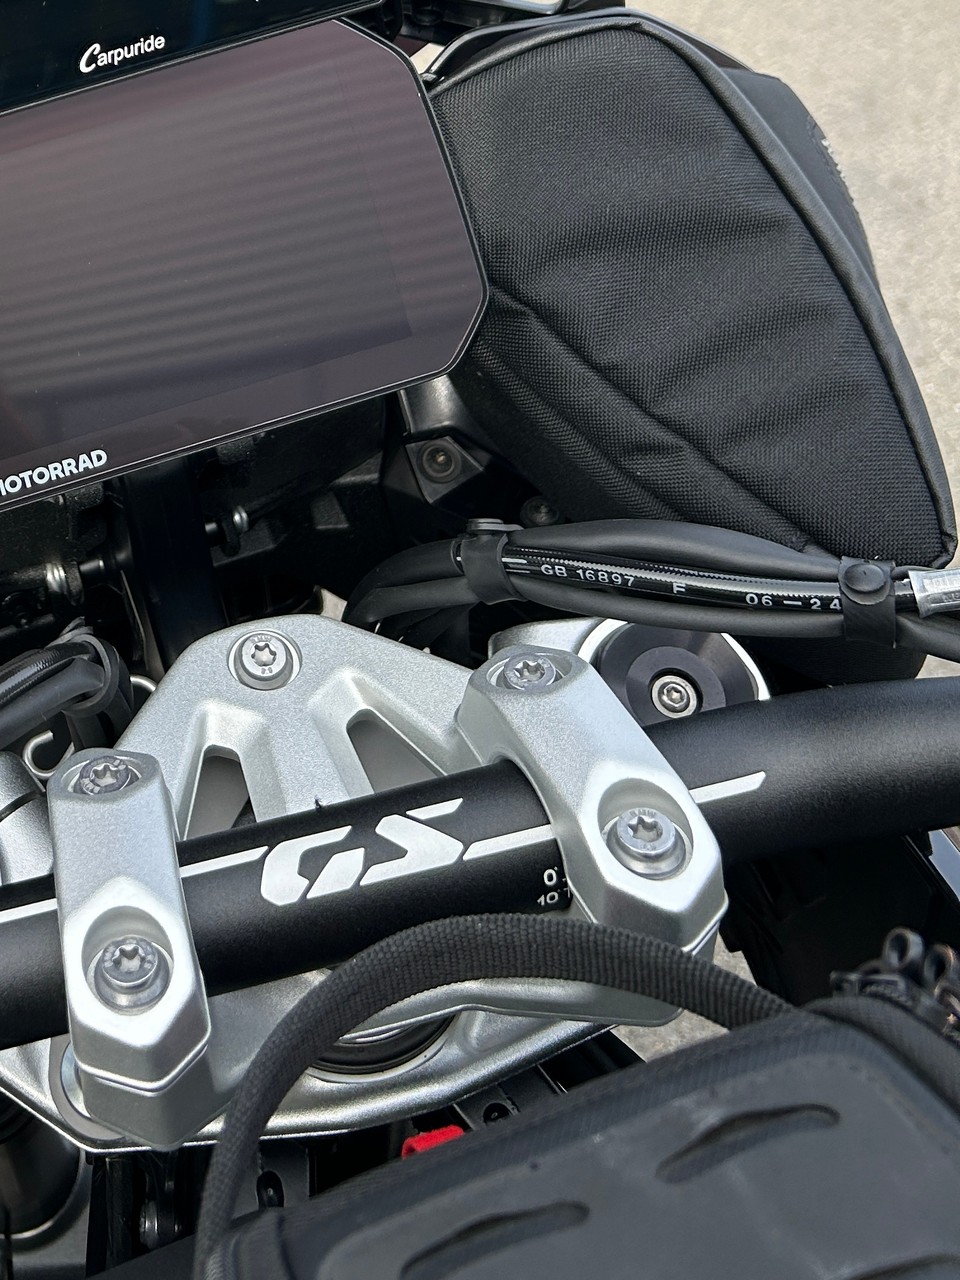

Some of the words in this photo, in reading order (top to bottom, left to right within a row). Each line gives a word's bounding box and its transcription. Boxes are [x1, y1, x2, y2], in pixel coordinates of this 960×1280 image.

[78, 34, 166, 73] Carpuride
[540, 564, 567, 578] GB
[576, 568, 635, 587] 16897
[745, 593, 773, 607] 06
[260, 798, 464, 907] GS
